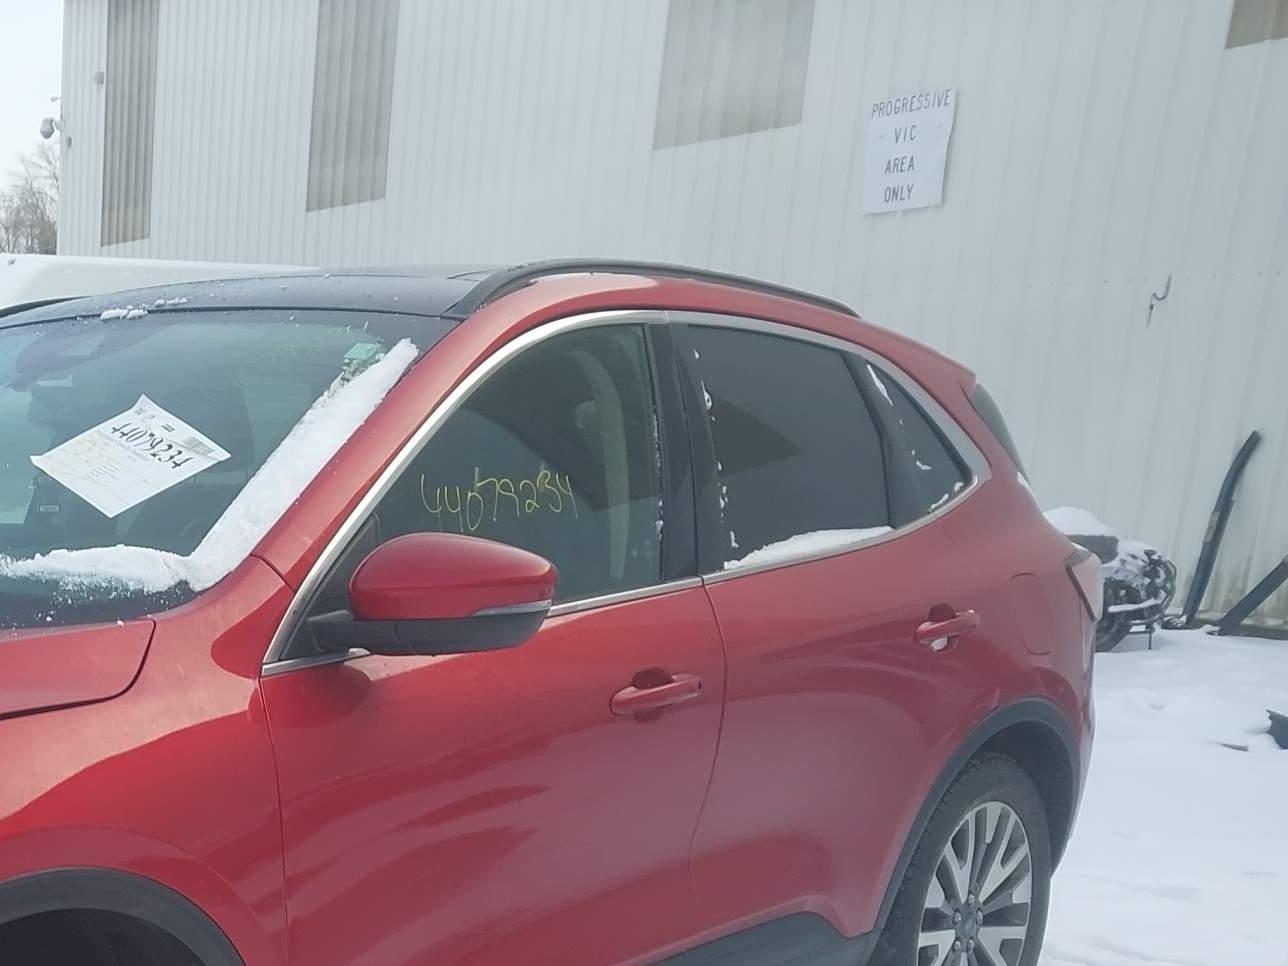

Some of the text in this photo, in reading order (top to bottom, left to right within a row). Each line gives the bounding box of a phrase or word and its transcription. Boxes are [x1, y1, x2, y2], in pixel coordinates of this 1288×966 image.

[872, 88, 952, 119] PROGRESSIVE
[894, 124, 917, 144] VIC
[884, 155, 915, 175] AREA
[884, 184, 914, 203] ONLY
[111, 422, 195, 469] 44079234
[420, 467, 579, 532] 44079234
